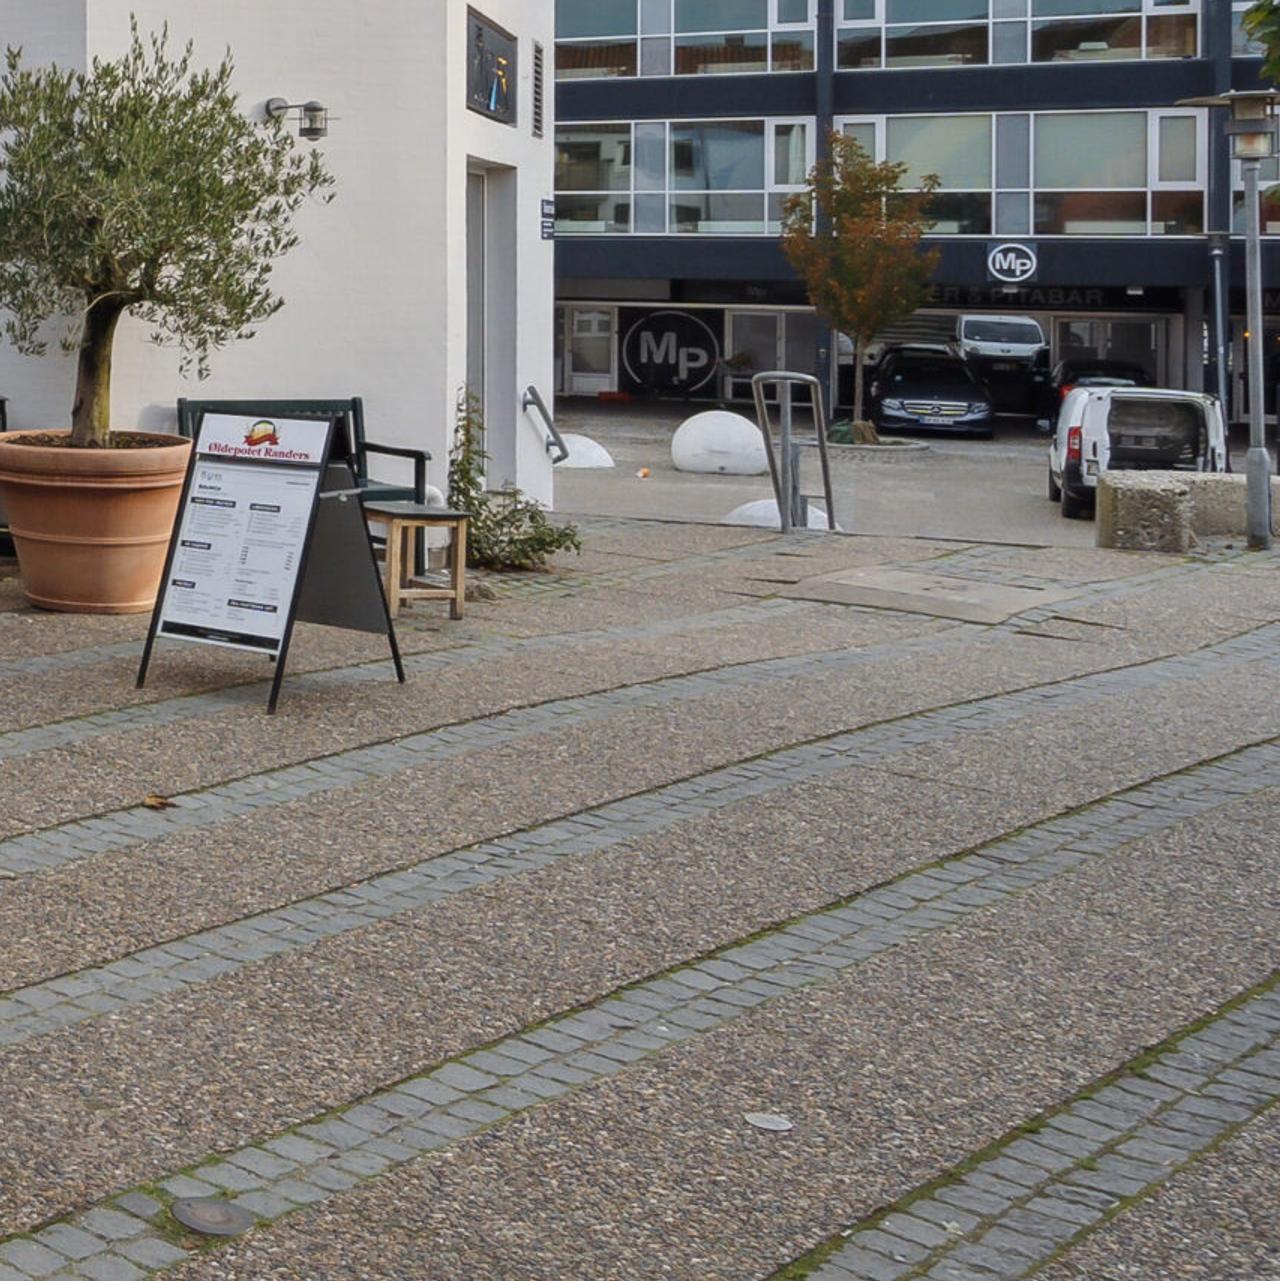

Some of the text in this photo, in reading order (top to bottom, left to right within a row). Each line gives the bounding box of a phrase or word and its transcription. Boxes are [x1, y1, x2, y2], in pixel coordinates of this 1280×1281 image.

[994, 252, 1032, 276] MP
[641, 331, 708, 380] MP
[208, 441, 310, 460] Øldepotet Randers
